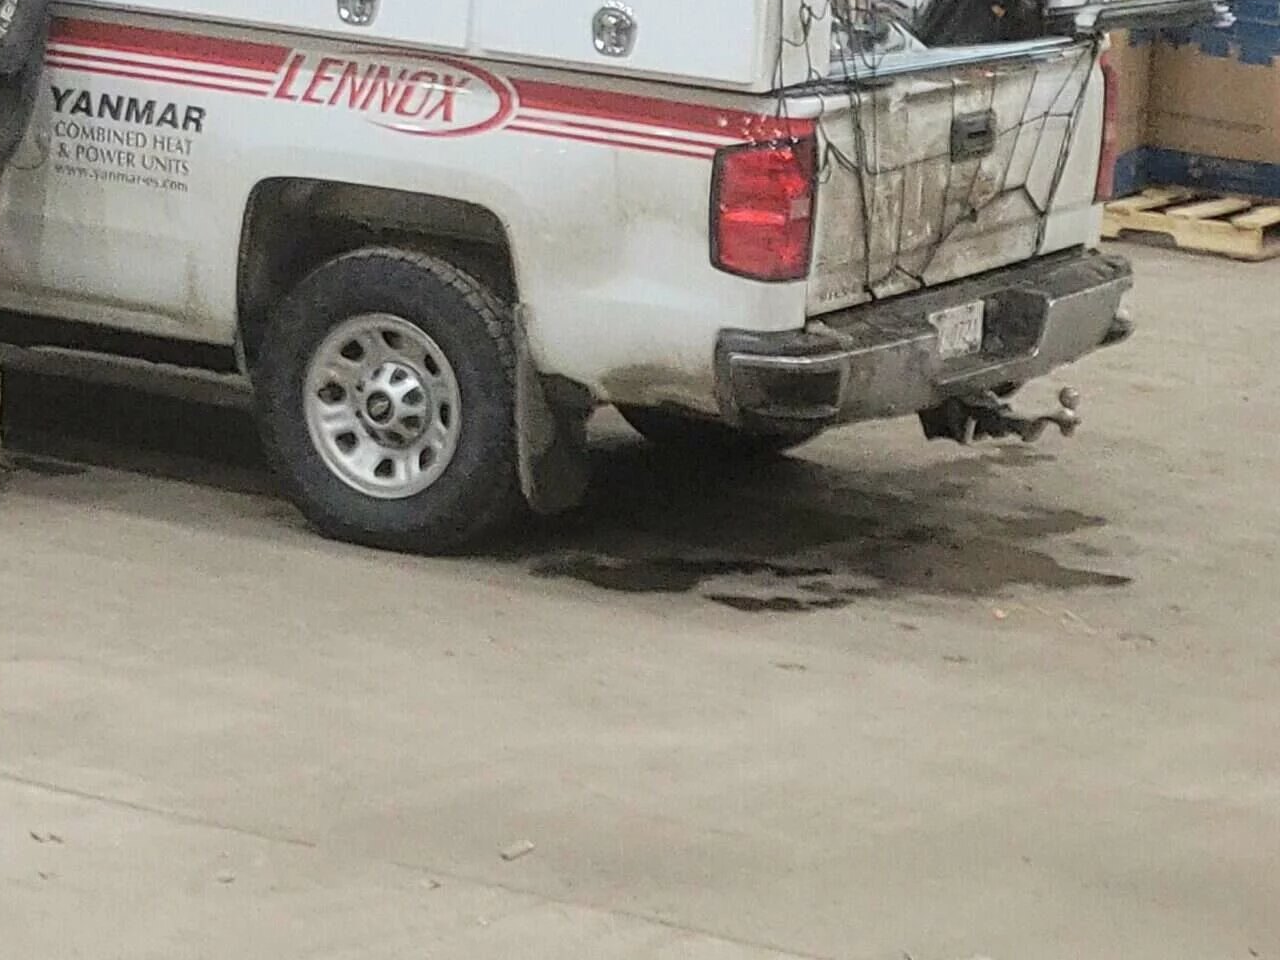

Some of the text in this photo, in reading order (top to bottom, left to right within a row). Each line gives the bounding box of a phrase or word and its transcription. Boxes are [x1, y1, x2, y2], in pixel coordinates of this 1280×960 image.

[50, 85, 207, 133] YANMAR
[274, 53, 472, 123] LENNOX
[55, 119, 194, 157] COMBINED HEAT
[58, 142, 191, 177] & POWER UNITS
